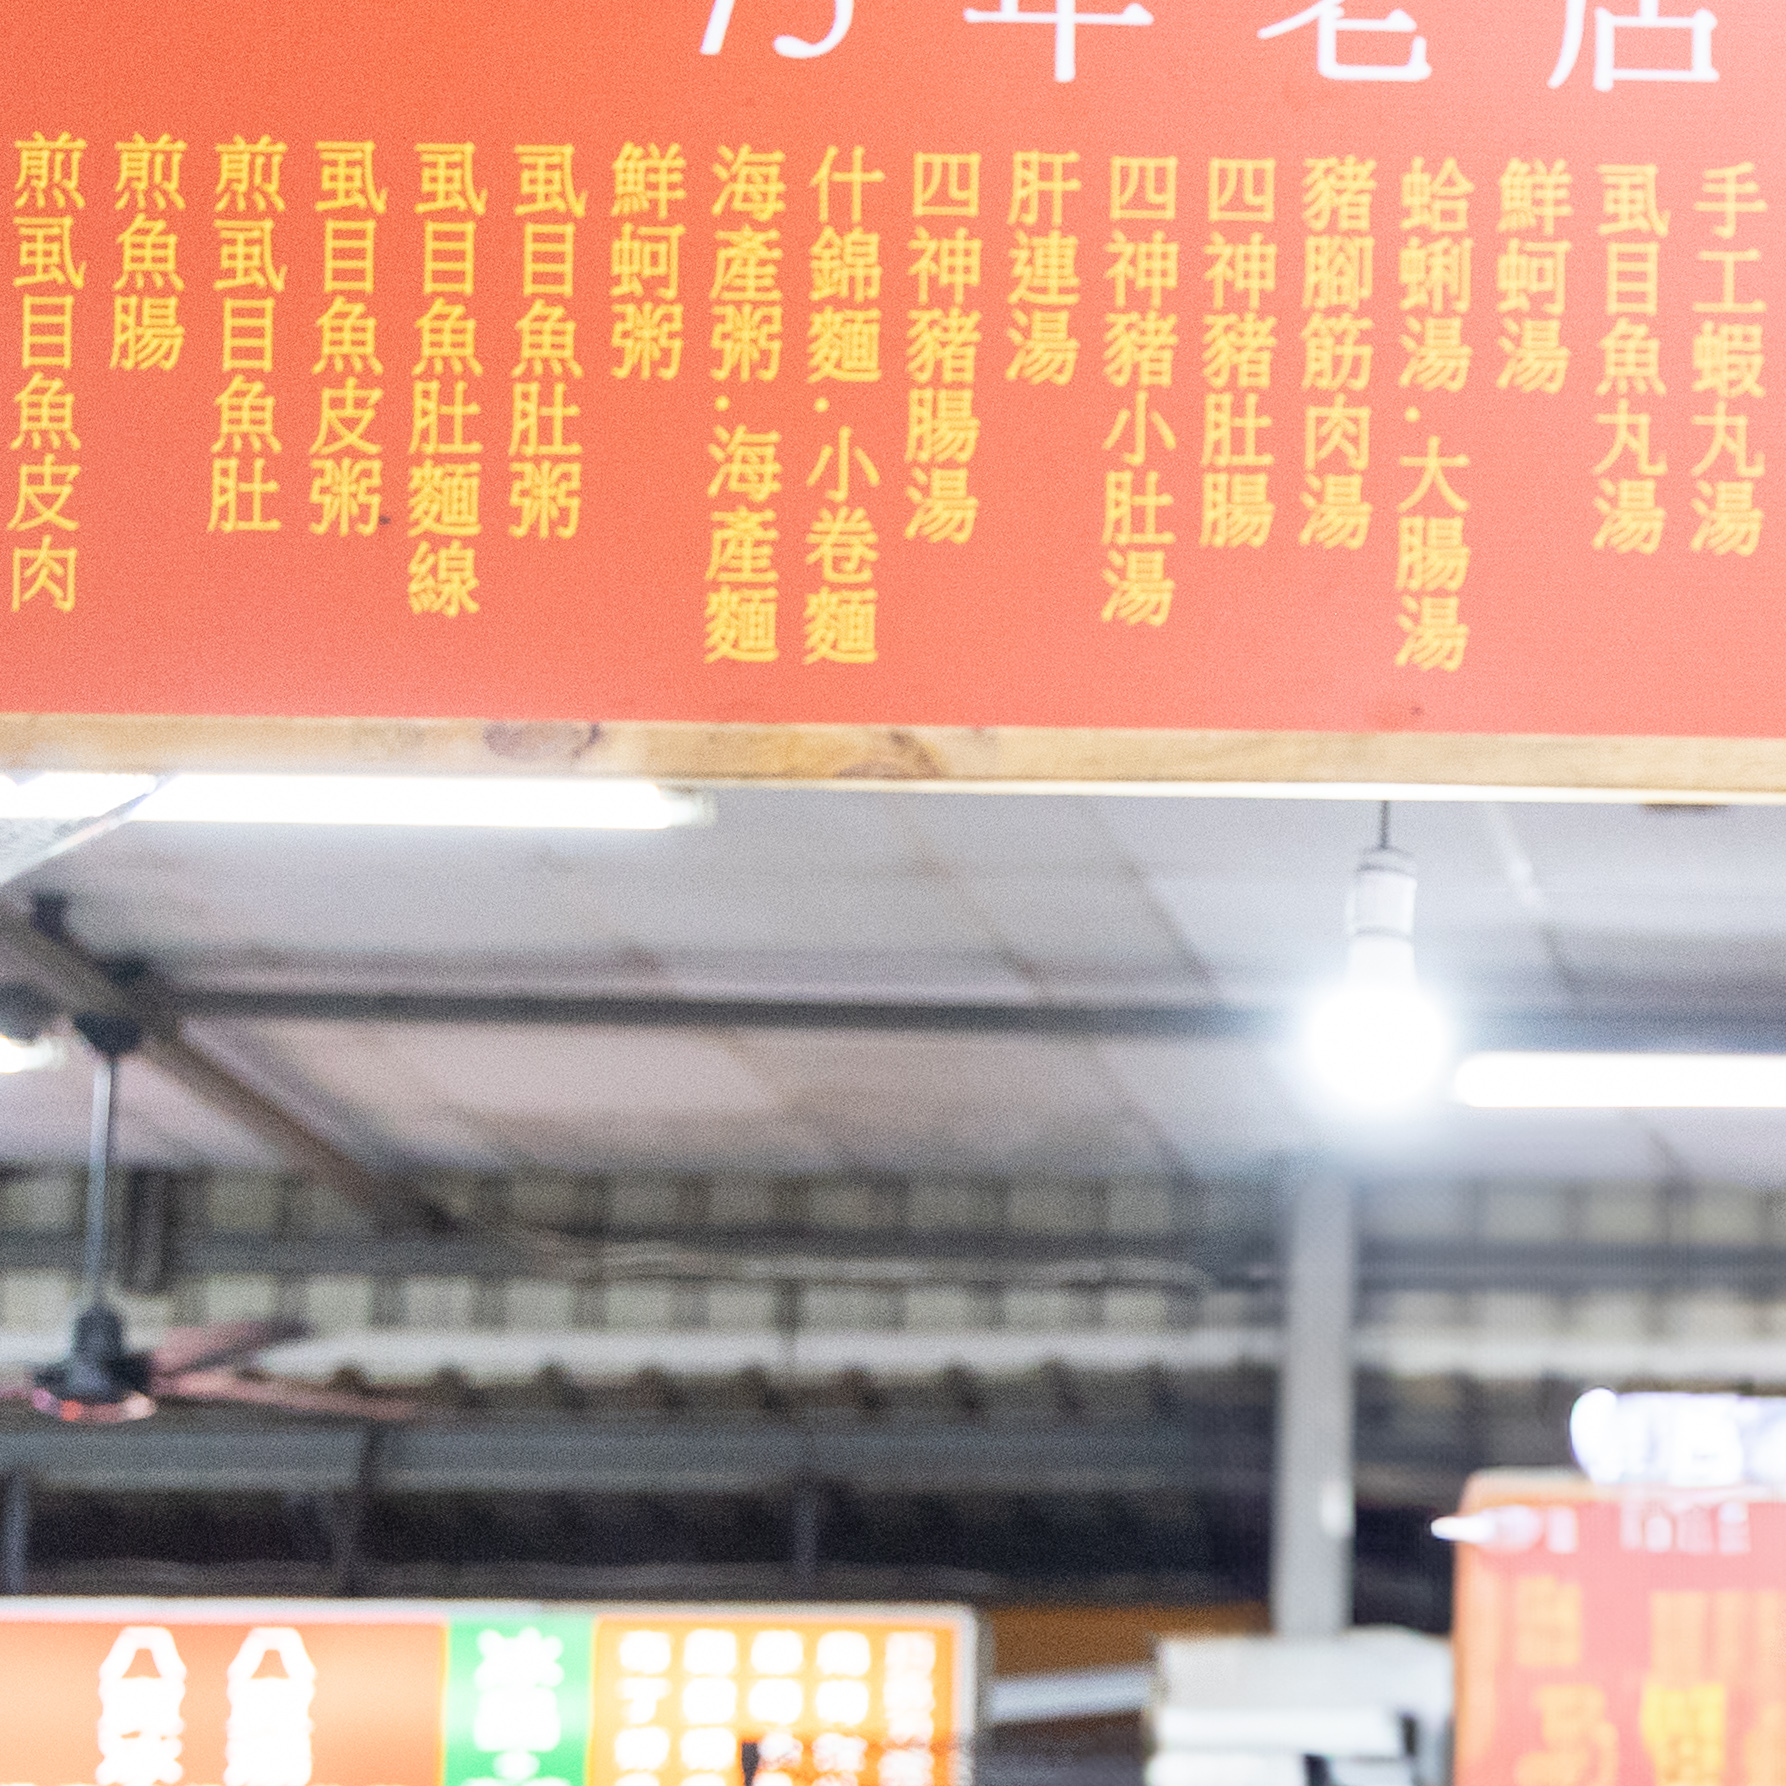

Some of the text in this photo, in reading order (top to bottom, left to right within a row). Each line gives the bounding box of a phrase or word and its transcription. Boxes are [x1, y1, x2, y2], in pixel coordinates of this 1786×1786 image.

[7, 132, 87, 612] 煎虱目魚皮肉
[110, 133, 187, 371] 煎魚腸
[208, 135, 287, 533] 煎虱目魚肚
[309, 140, 387, 537] 虱目魚皮粥
[407, 142, 487, 618] 虱目魚肚麵線
[508, 144, 587, 540] 虱目魚肚粥
[610, 142, 686, 380] 鮮蚵粥
[905, 152, 982, 544] 四神豬腸湯
[1006, 150, 1081, 385] 肝連湯
[1101, 155, 1179, 627] 四神豬小肚湯
[1200, 157, 1277, 548] 四神豬肚腸
[1298, 155, 1377, 550] 豬腳筋肉湯
[1496, 158, 1573, 394] 鮮蚵湯
[1592, 164, 1669, 554] 虱目魚丸湯
[1690, 162, 1767, 556] 手工蝦丸湯
